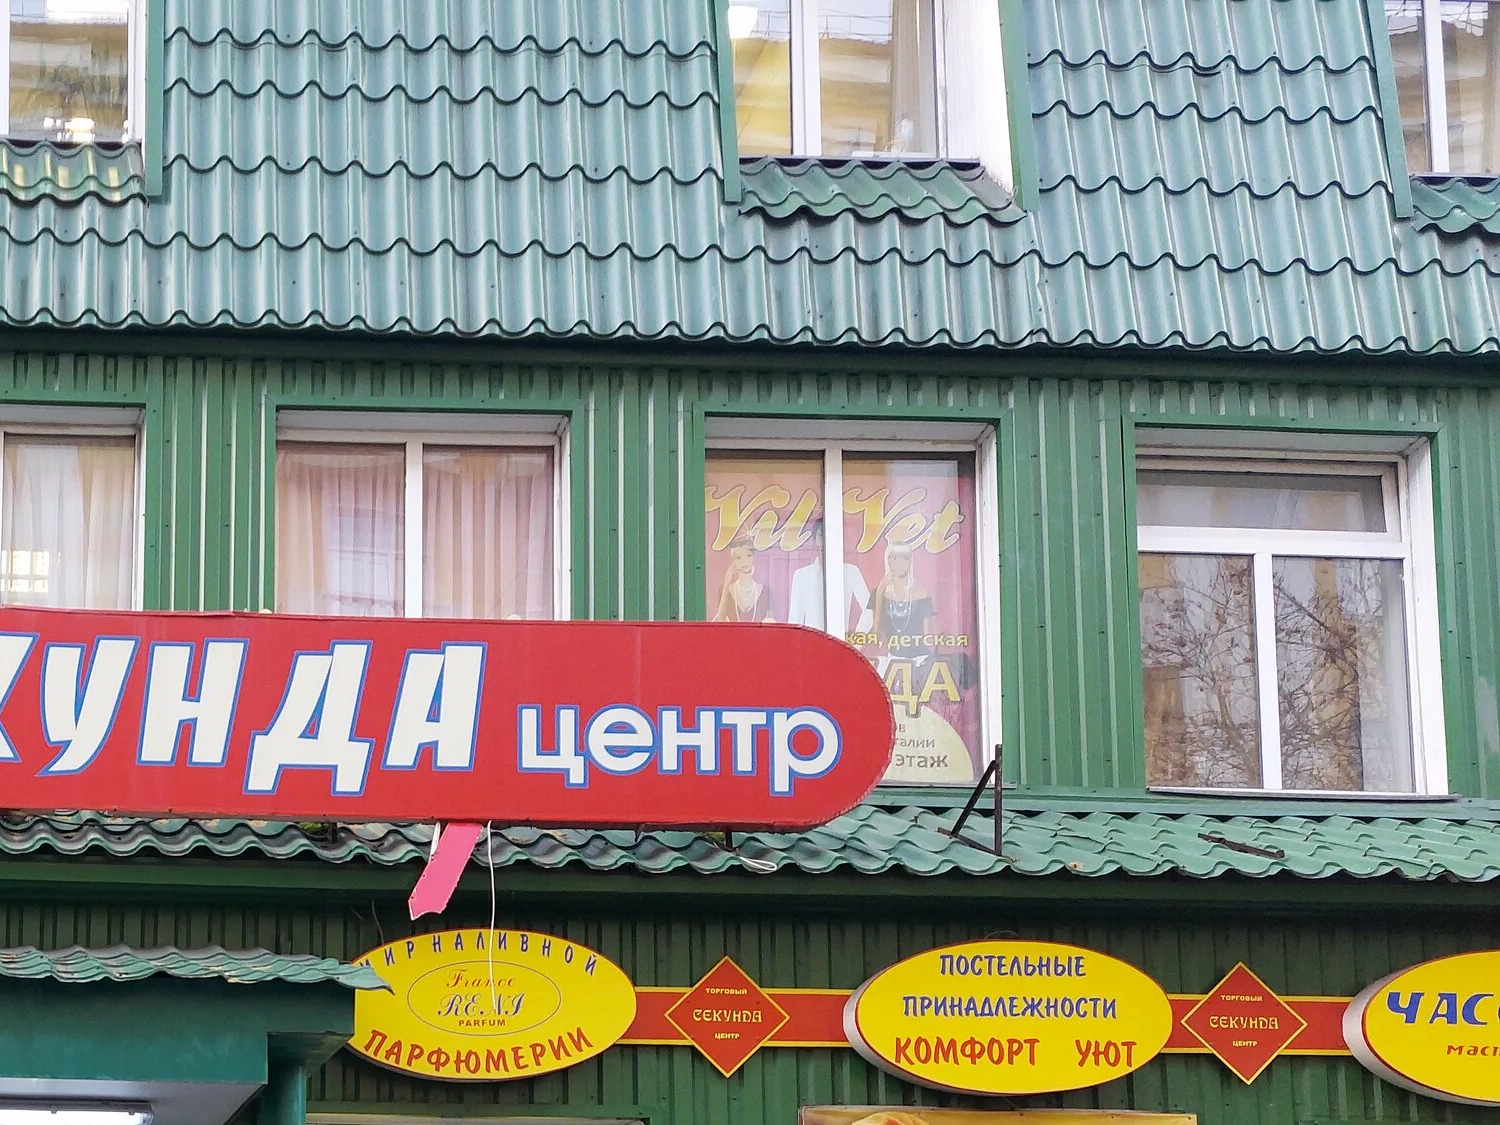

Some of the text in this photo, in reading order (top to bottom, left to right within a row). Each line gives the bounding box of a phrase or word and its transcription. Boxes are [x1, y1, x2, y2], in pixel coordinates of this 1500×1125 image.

[705, 484, 965, 554] Vil Vet
[888, 633, 968, 650] детская
[870, 657, 962, 717] ДА
[517, 703, 843, 797] центр
[895, 754, 948, 768] этаж
[359, 931, 597, 976] ИР НАЛИВНОЙ
[939, 954, 1087, 978] ПОСТЕЛЬНЫЕ
[446, 969, 516, 989] France
[705, 987, 748, 995] ТОРГОВЫЙ
[1220, 994, 1263, 1002] ТОРГОВЫЙ
[693, 1008, 763, 1024] СЕКУНДА
[902, 994, 1117, 1020] ПРИНАДЛЕЖНОСТИ
[1387, 992, 1500, 1026] ЧАС
[458, 1019, 506, 1027] PARFUM
[1209, 1014, 1279, 1031] СЕКУНДА
[714, 1032, 740, 1040] ЦЕНТР
[1232, 1039, 1258, 1047] ЦЕНТР
[364, 1026, 593, 1074] ПАРФЮМЕРИИ
[894, 1036, 1138, 1068] КОМФОРТ УЮТ
